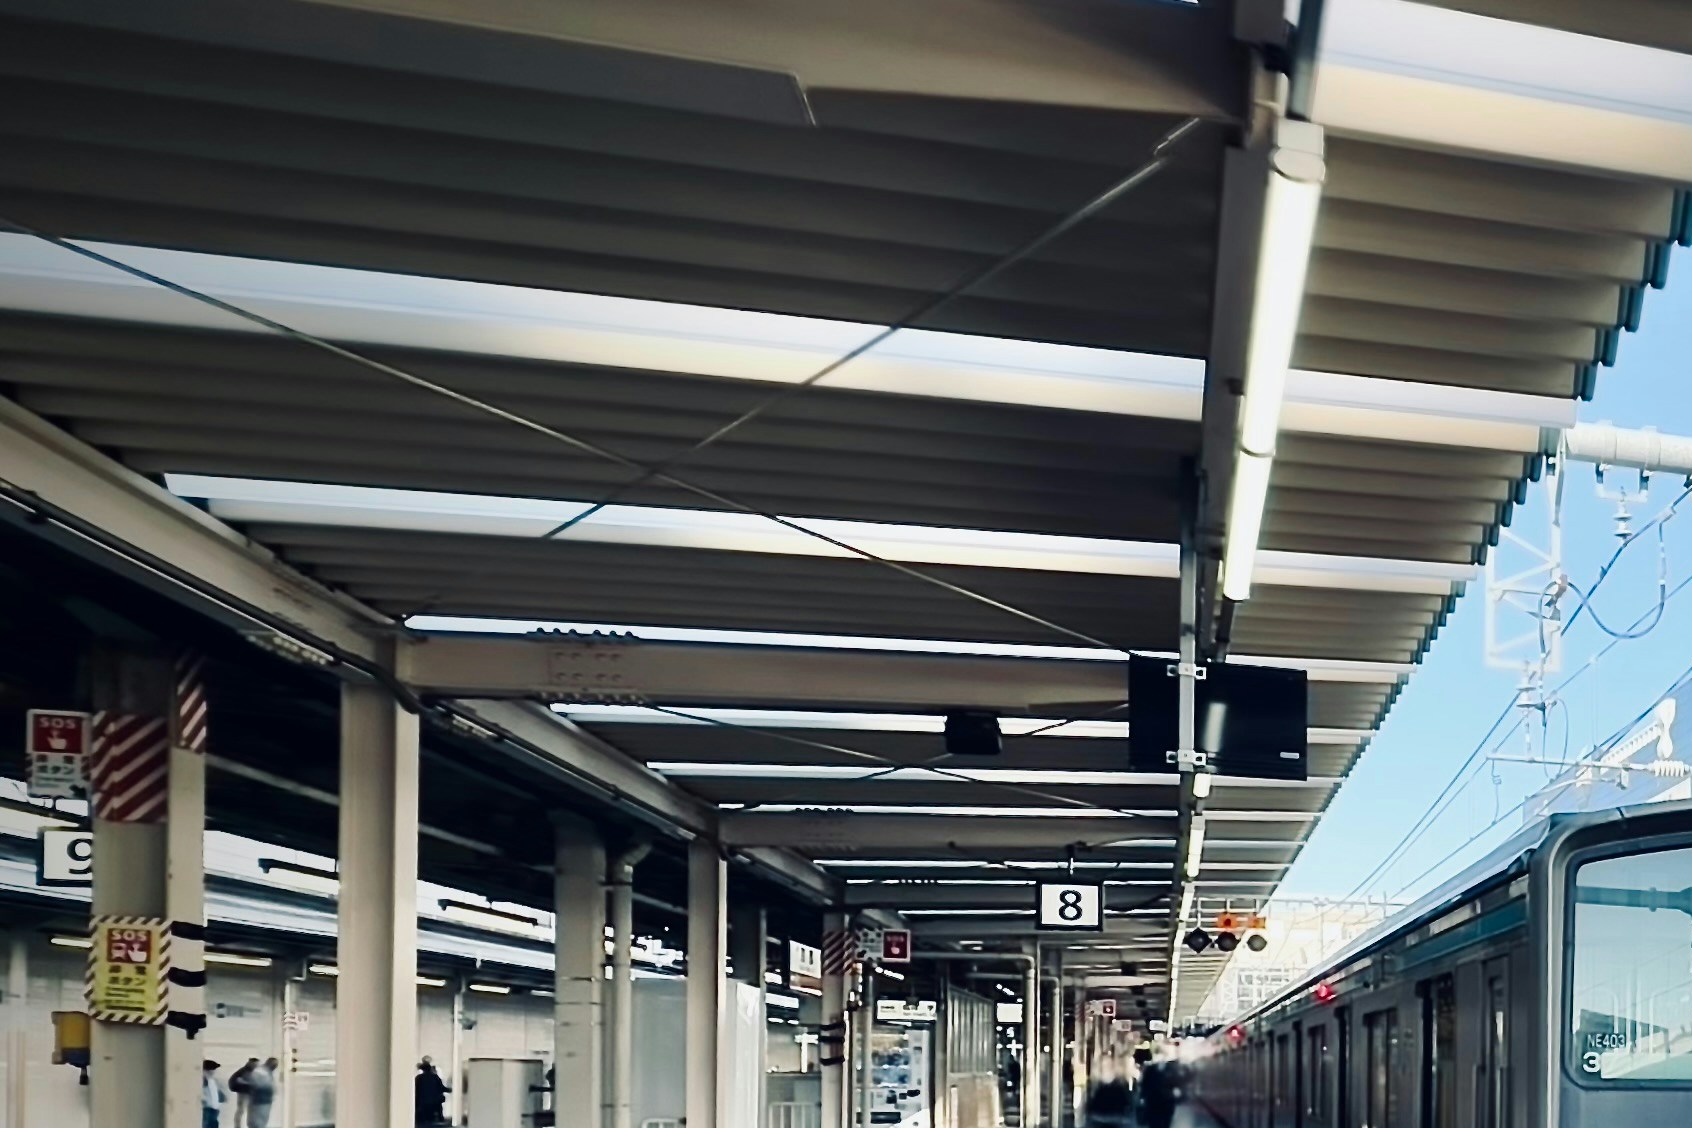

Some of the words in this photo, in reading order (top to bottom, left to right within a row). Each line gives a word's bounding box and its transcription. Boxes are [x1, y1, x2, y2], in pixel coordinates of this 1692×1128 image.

[39, 717, 77, 729] SOS
[67, 838, 93, 875] 9
[1057, 889, 1083, 921] 8
[111, 929, 148, 942] SOS
[1587, 1033, 1626, 1048] NE403
